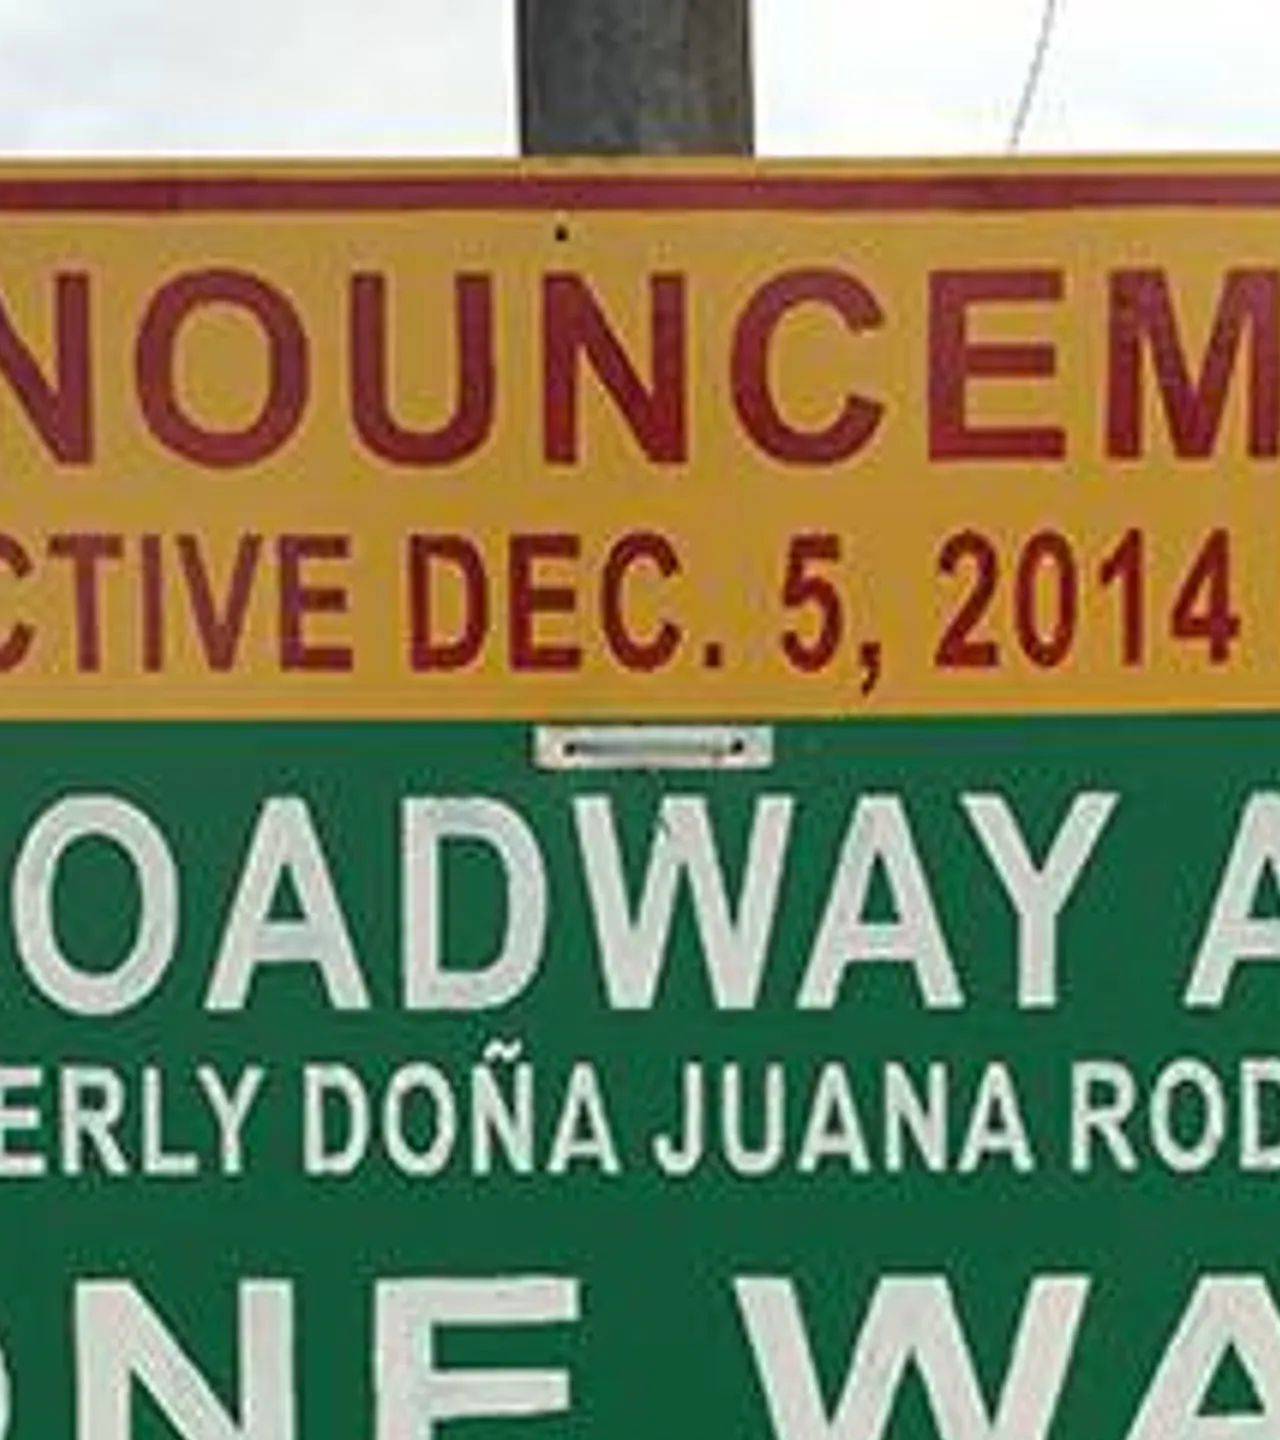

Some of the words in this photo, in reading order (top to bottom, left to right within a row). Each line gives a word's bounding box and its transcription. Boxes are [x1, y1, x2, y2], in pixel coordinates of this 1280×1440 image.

[407, 531, 724, 673] DEC.
[780, 533, 881, 697] 5,
[934, 527, 1241, 671] 2014
[305, 1041, 618, 1174] DOÑA
[655, 1063, 1032, 1173] JUANA
